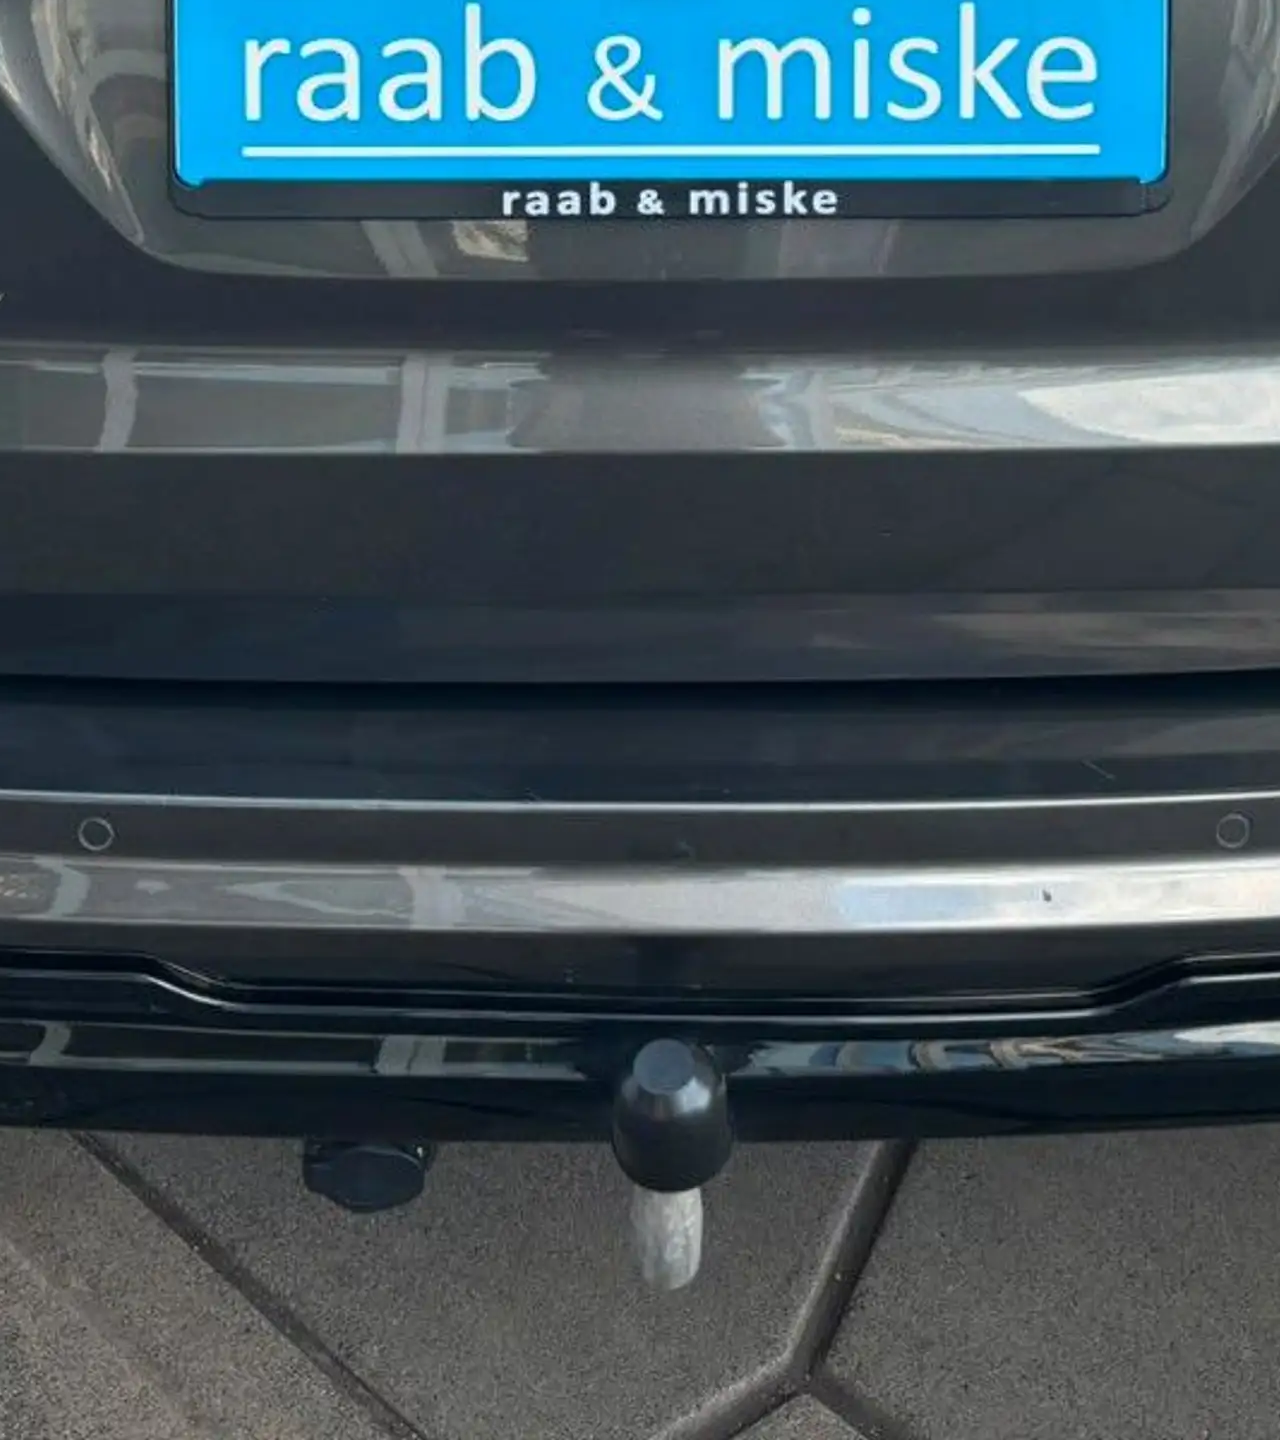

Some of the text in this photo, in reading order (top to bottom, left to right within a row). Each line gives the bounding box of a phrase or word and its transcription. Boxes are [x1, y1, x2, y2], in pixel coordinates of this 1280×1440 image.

[242, 0, 1100, 123] raab & miske
[501, 182, 839, 218] raab & miske
